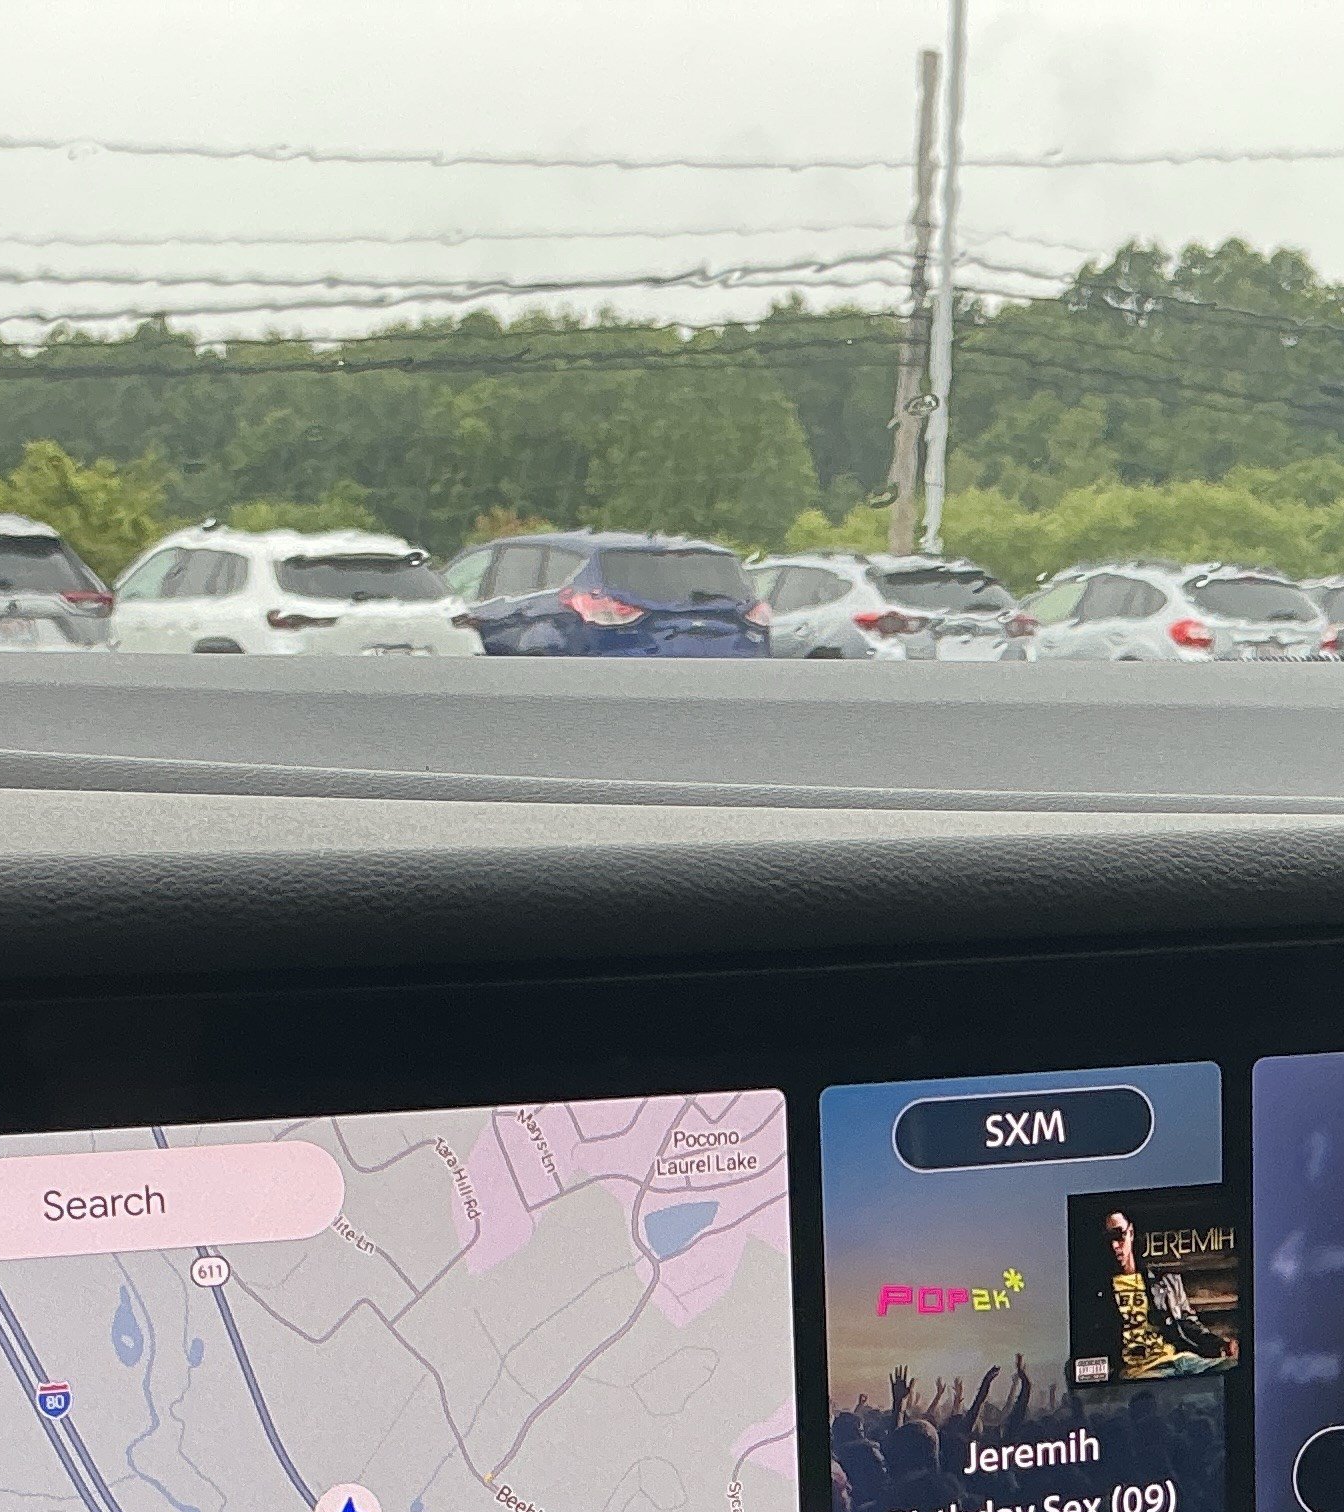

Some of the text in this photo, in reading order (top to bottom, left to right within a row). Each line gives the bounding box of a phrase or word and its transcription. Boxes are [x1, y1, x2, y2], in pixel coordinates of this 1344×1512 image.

[517, 1109, 548, 1151] Marys
[673, 1130, 740, 1149] Pocono
[984, 1109, 1066, 1149] SXM
[436, 1136, 482, 1220] Tara Hill Rd
[657, 1151, 757, 1176] Laurel Lake
[43, 1185, 166, 1221] Search
[1141, 1228, 1235, 1259] JEREMIH
[197, 1261, 224, 1281] 611
[45, 1394, 65, 1410] 80
[964, 1428, 1101, 1475] Jeremih
